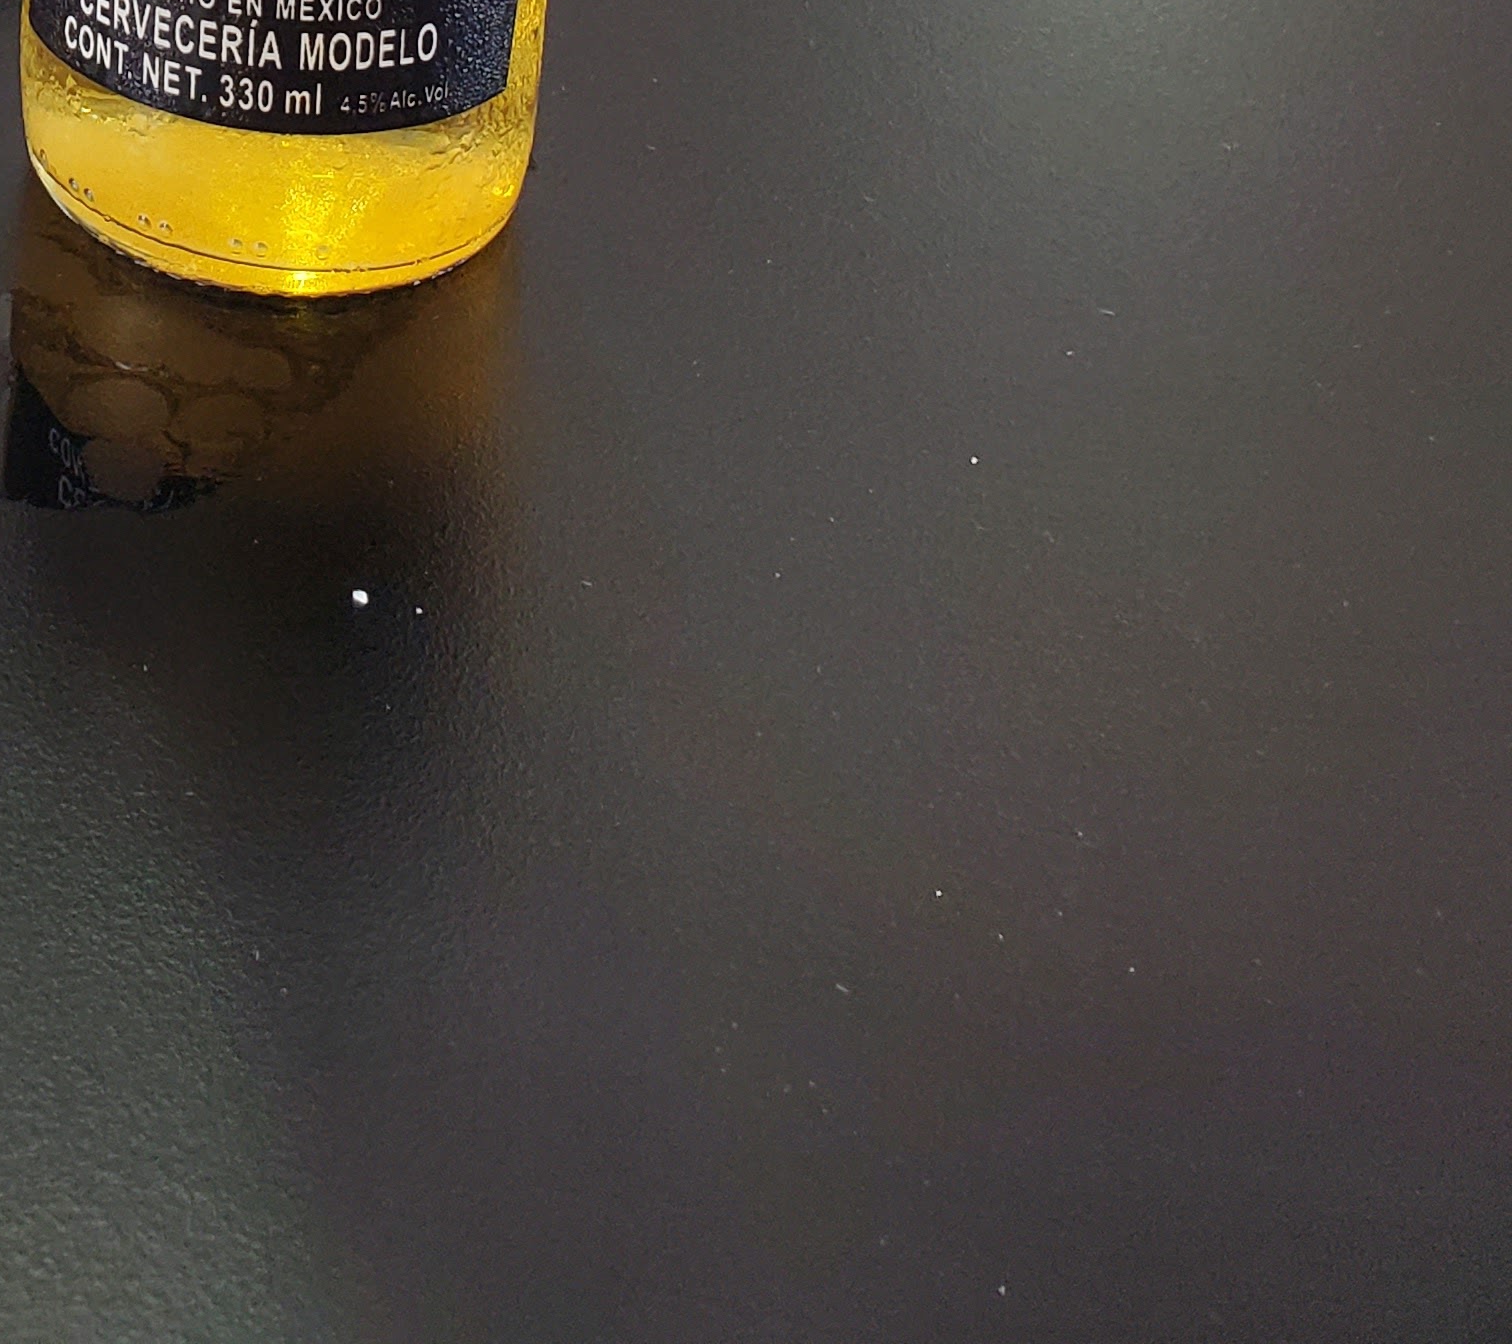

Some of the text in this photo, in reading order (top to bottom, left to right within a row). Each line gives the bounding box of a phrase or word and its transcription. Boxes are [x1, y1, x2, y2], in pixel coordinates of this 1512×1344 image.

[299, 22, 438, 72] MODELO
[142, 52, 208, 103] NET.
[219, 74, 274, 112] 330
[284, 82, 322, 115] ml
